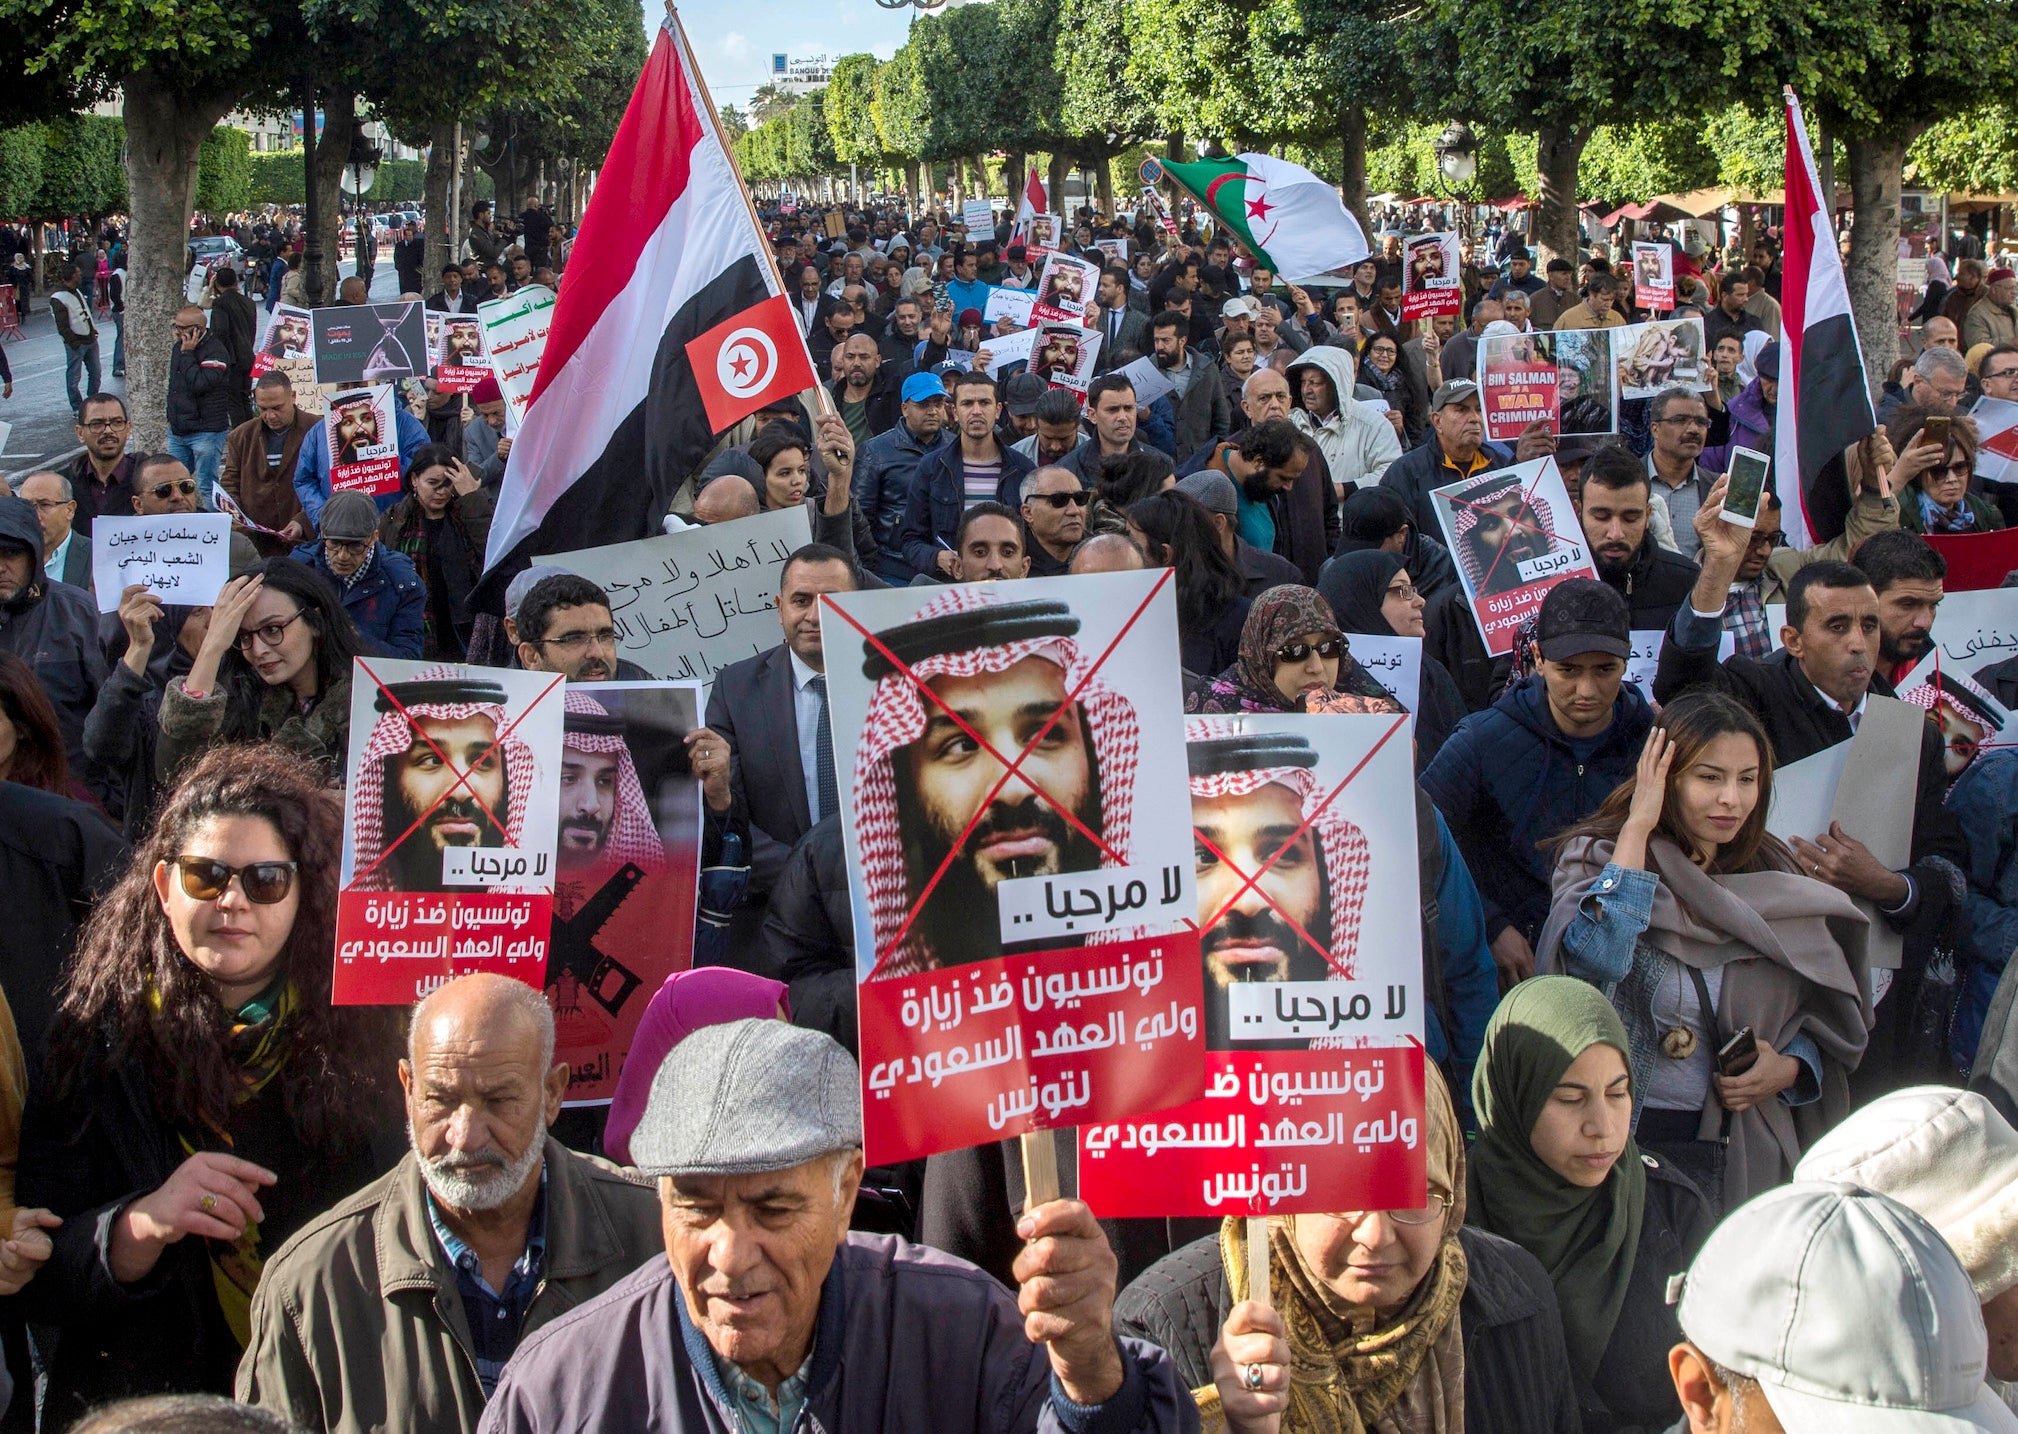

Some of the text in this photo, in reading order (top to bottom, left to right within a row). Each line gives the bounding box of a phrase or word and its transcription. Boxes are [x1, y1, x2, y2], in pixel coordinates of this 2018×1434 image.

[1060, 374, 1079, 385] مرحبا
[1488, 372, 1555, 386] BIN SALMAN
[1521, 385, 1530, 393] A
[1498, 394, 1544, 409] WAR
[1489, 409, 1556, 424] CRIMINAL
[366, 446, 387, 458] مرحبا
[390, 443, 395, 452] لا
[337, 467, 350, 479] زيارة
[362, 460, 391, 474] تونسيون
[333, 470, 398, 491] ولي العهد السعودي
[109, 528, 218, 546] بن سلمان يا جبان
[118, 551, 203, 569] الشعب اليمني
[706, 540, 761, 579] أهلا
[1533, 554, 1568, 575] مرحبا
[1572, 548, 1581, 561] لا
[1489, 595, 1513, 613] زيارة
[1361, 652, 1401, 670] تونس
[471, 851, 527, 882] مرحبا
[534, 853, 548, 876] لا
[1160, 865, 1182, 905] لا
[365, 900, 408, 930] زيارة
[451, 901, 530, 930] تونسيون
[1044, 879, 1147, 930] مرحبا
[340, 935, 545, 963] ولي العهد السعودي
[1022, 949, 1163, 1013] تونسيون
[901, 980, 962, 1034] زيارة
[1275, 987, 1371, 1033] مرحبا
[1384, 985, 1406, 1020] لا
[868, 1001, 1197, 1100] ولي العهد السعودي
[1249, 1060, 1384, 1105] تونسيون
[987, 1070, 1091, 1131] لتونس
[1085, 1110, 1417, 1158] ولي العهد السعودي
[1203, 1163, 1307, 1205] لتونس
